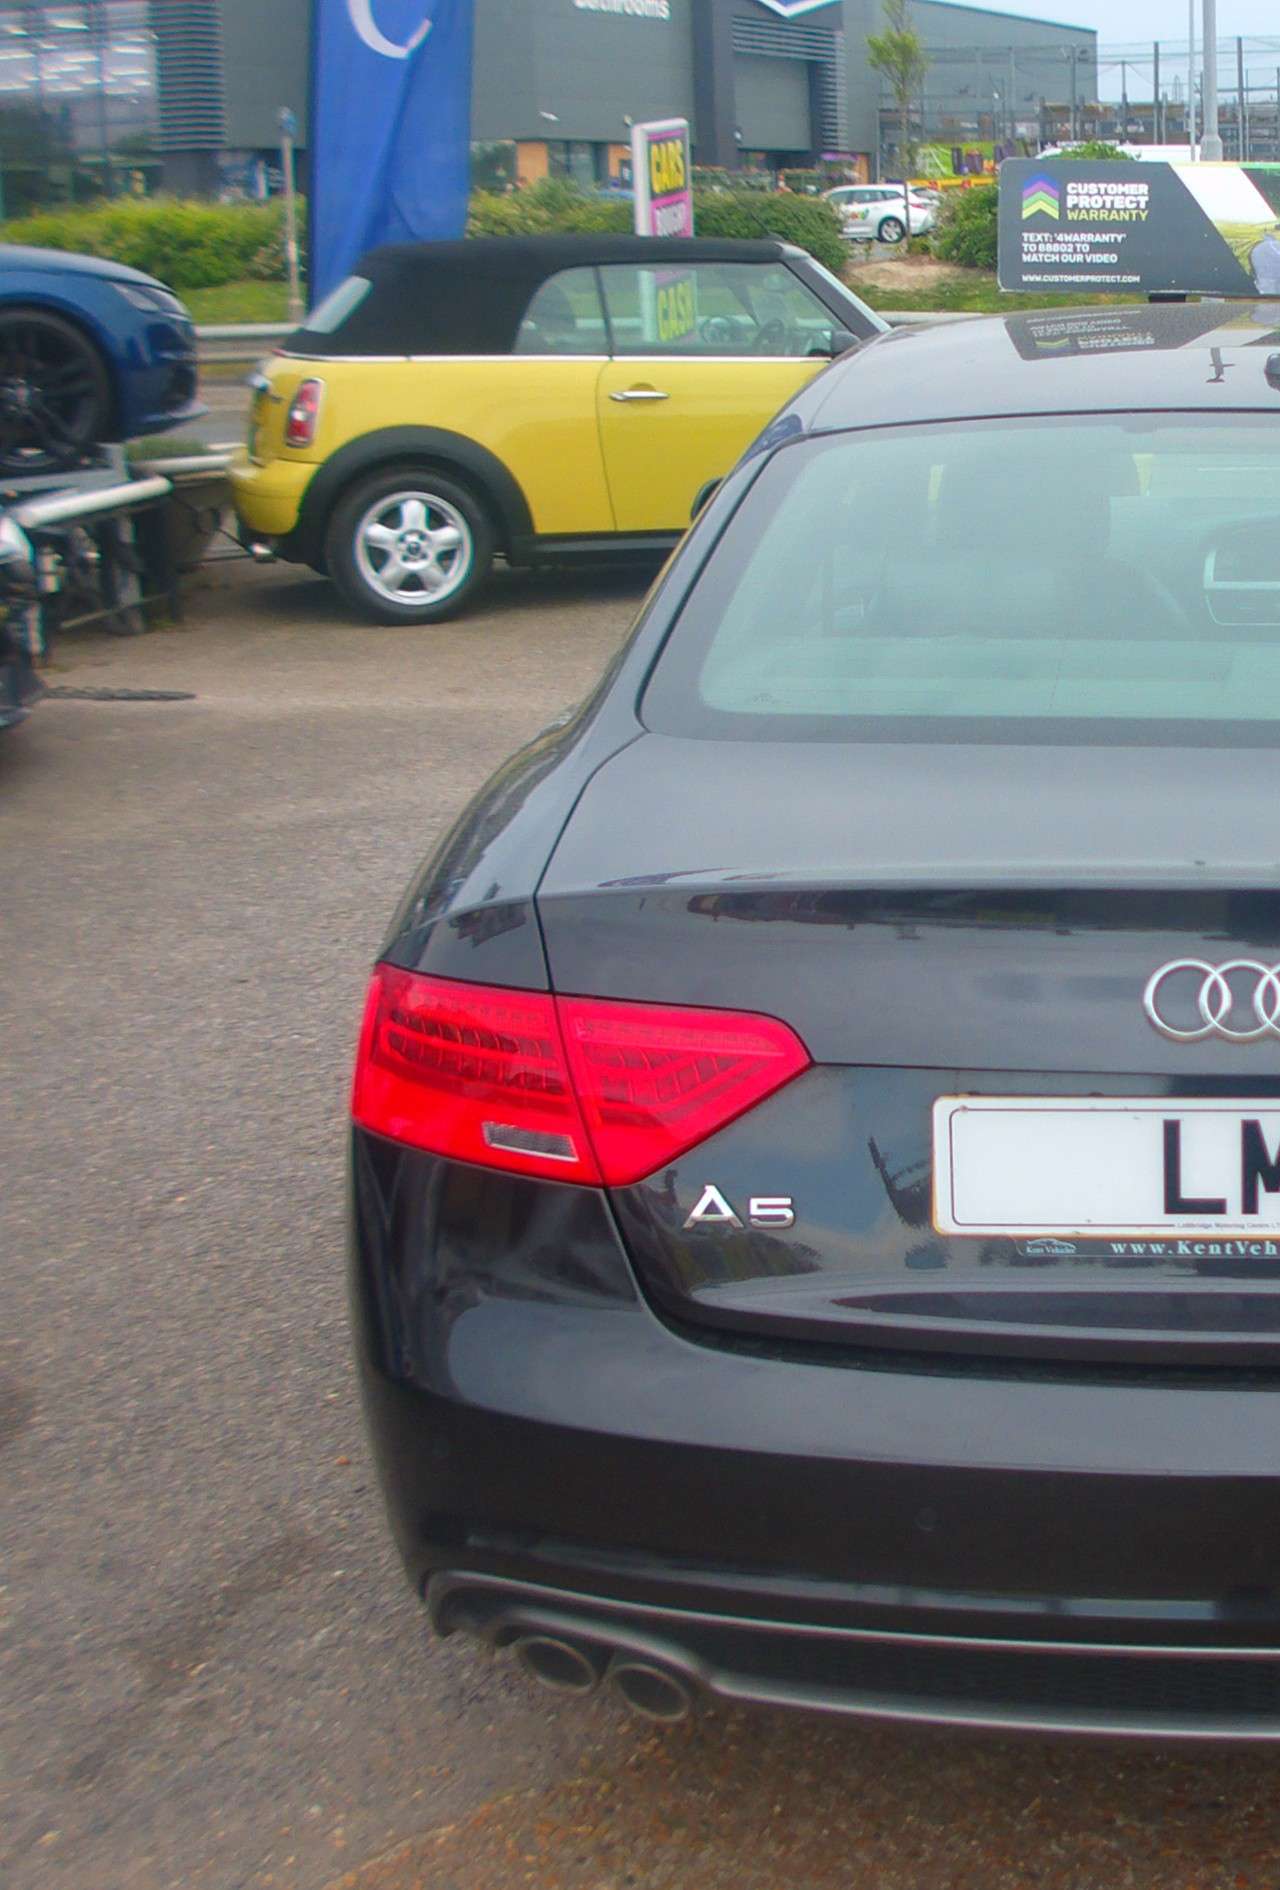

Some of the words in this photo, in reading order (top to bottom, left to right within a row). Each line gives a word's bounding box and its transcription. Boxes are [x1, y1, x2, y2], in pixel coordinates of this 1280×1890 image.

[651, 139, 685, 193] CARS
[1066, 183, 1149, 195] CUSTOMER
[1066, 195, 1149, 209] PROTECT
[1066, 210, 1149, 221] WARRANTY
[1022, 232, 1053, 243] TEXT:
[1022, 243, 1037, 253] TO
[1076, 243, 1090, 253] TO
[1022, 253, 1060, 263] WATCH
[1061, 253, 1084, 263] OUR
[1085, 254, 1118, 264] VIDEO
[1022, 274, 1140, 283] WWW.CUSTOMERPROTECT.COM
[682, 1184, 795, 1229] A5
